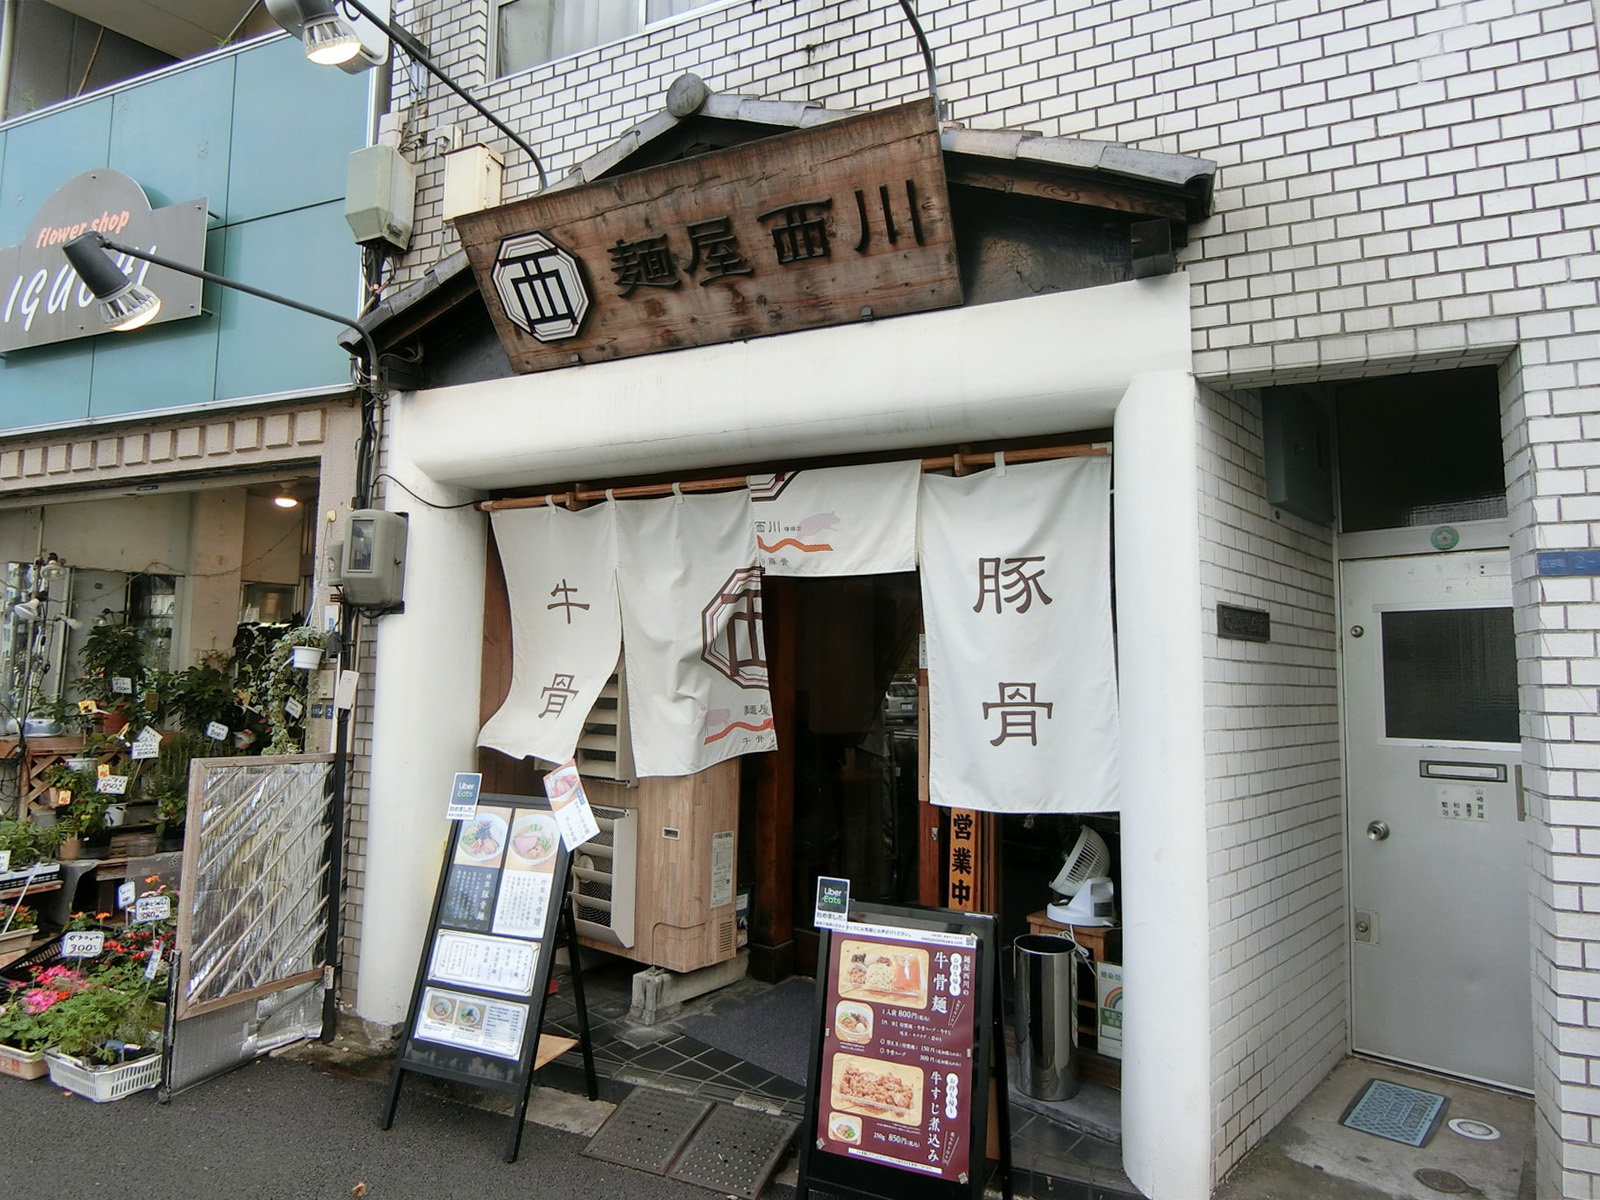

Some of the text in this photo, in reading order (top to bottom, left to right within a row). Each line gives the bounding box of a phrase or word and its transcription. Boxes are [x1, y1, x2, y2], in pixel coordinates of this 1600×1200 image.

[36, 210, 130, 249] flower shop
[607, 178, 925, 299] 麺屋西川
[538, 578, 590, 719] 牛骨
[973, 556, 1053, 746] 豚骨
[458, 782, 474, 790] Uber
[824, 886, 843, 897] Uber
[951, 813, 973, 906] 営業中
[822, 894, 842, 905] Eats
[932, 952, 950, 1015] 牛骨麺
[928, 1071, 943, 1162] 牛すじ煮込み
